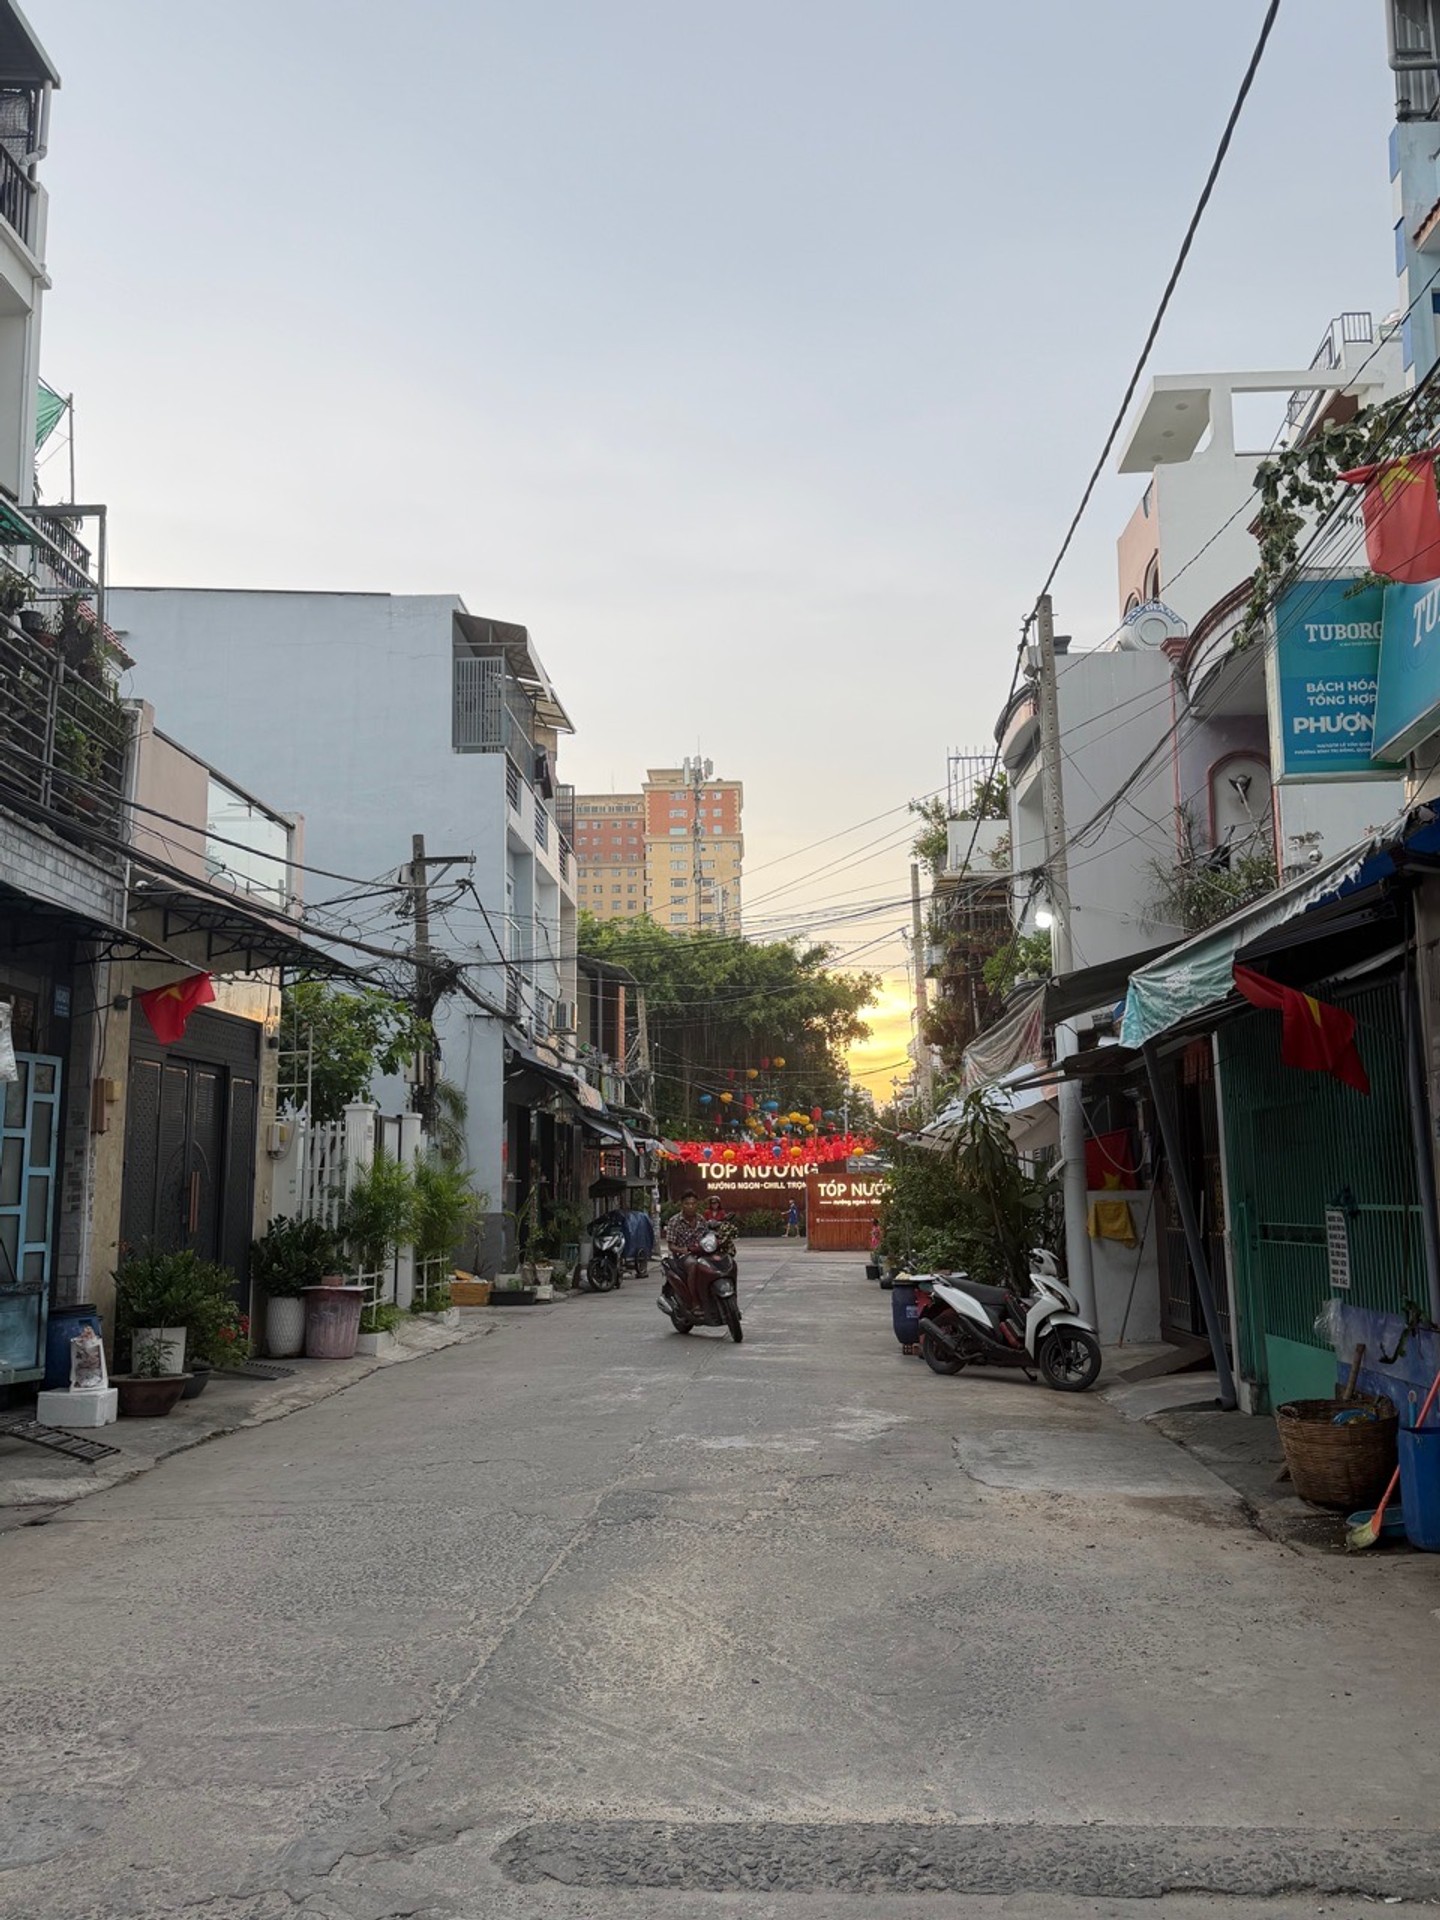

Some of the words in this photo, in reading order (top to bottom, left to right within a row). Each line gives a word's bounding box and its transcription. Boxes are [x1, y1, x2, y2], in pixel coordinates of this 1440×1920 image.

[1413, 584, 1440, 648] TU
[1306, 679, 1345, 693] BÁCH
[1347, 678, 1378, 692] HÓA
[1306, 692, 1346, 706] TỔNG
[1348, 692, 1377, 706] HỢP
[817, 1179, 848, 1197] TÓP
